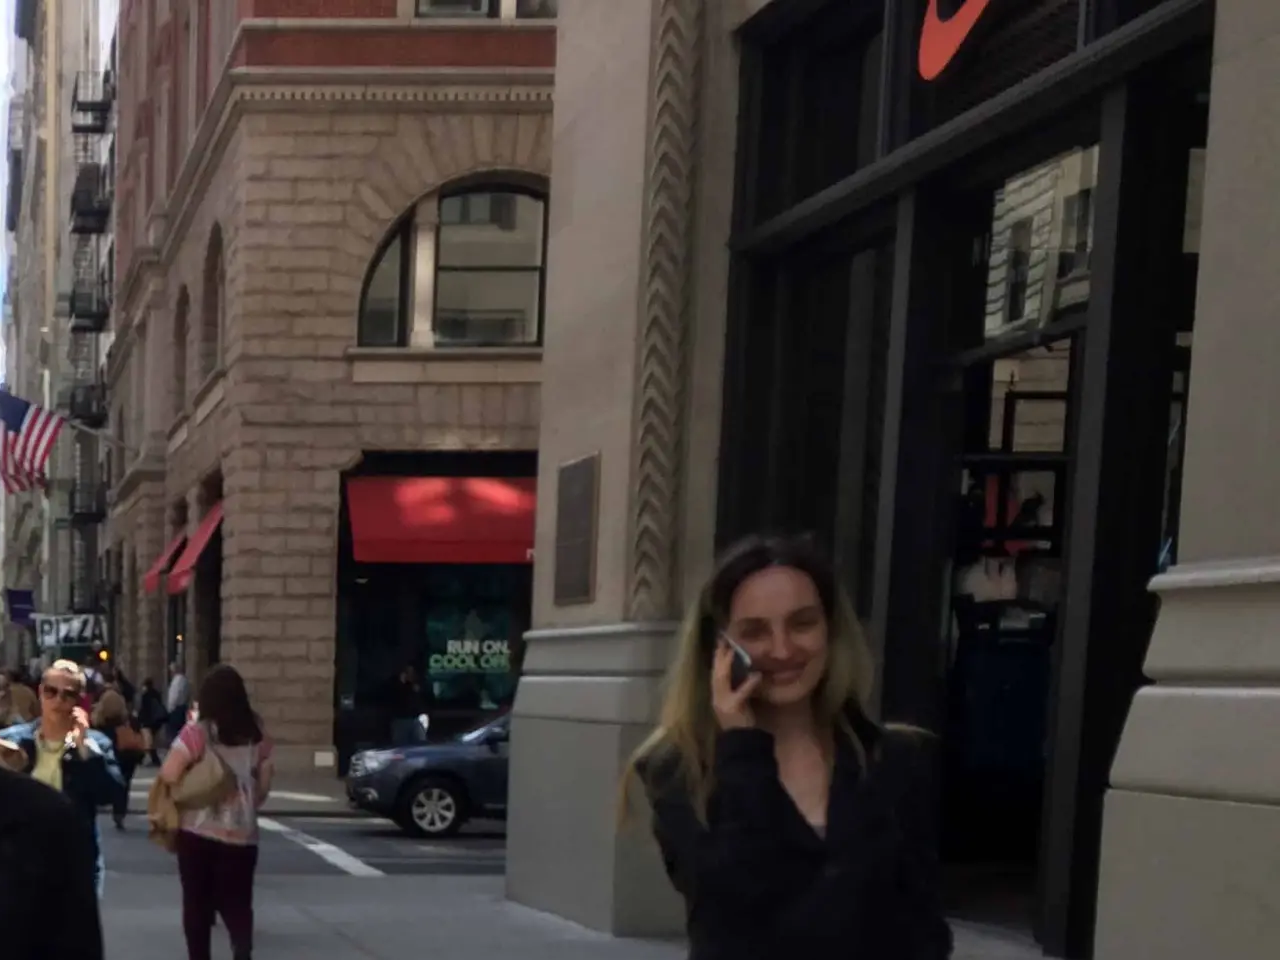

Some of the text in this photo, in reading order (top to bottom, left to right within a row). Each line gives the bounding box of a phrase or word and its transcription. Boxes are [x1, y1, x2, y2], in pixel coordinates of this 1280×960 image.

[40, 617, 105, 646] PIZZA
[447, 640, 480, 654] RUN
[429, 653, 476, 668] COOL
